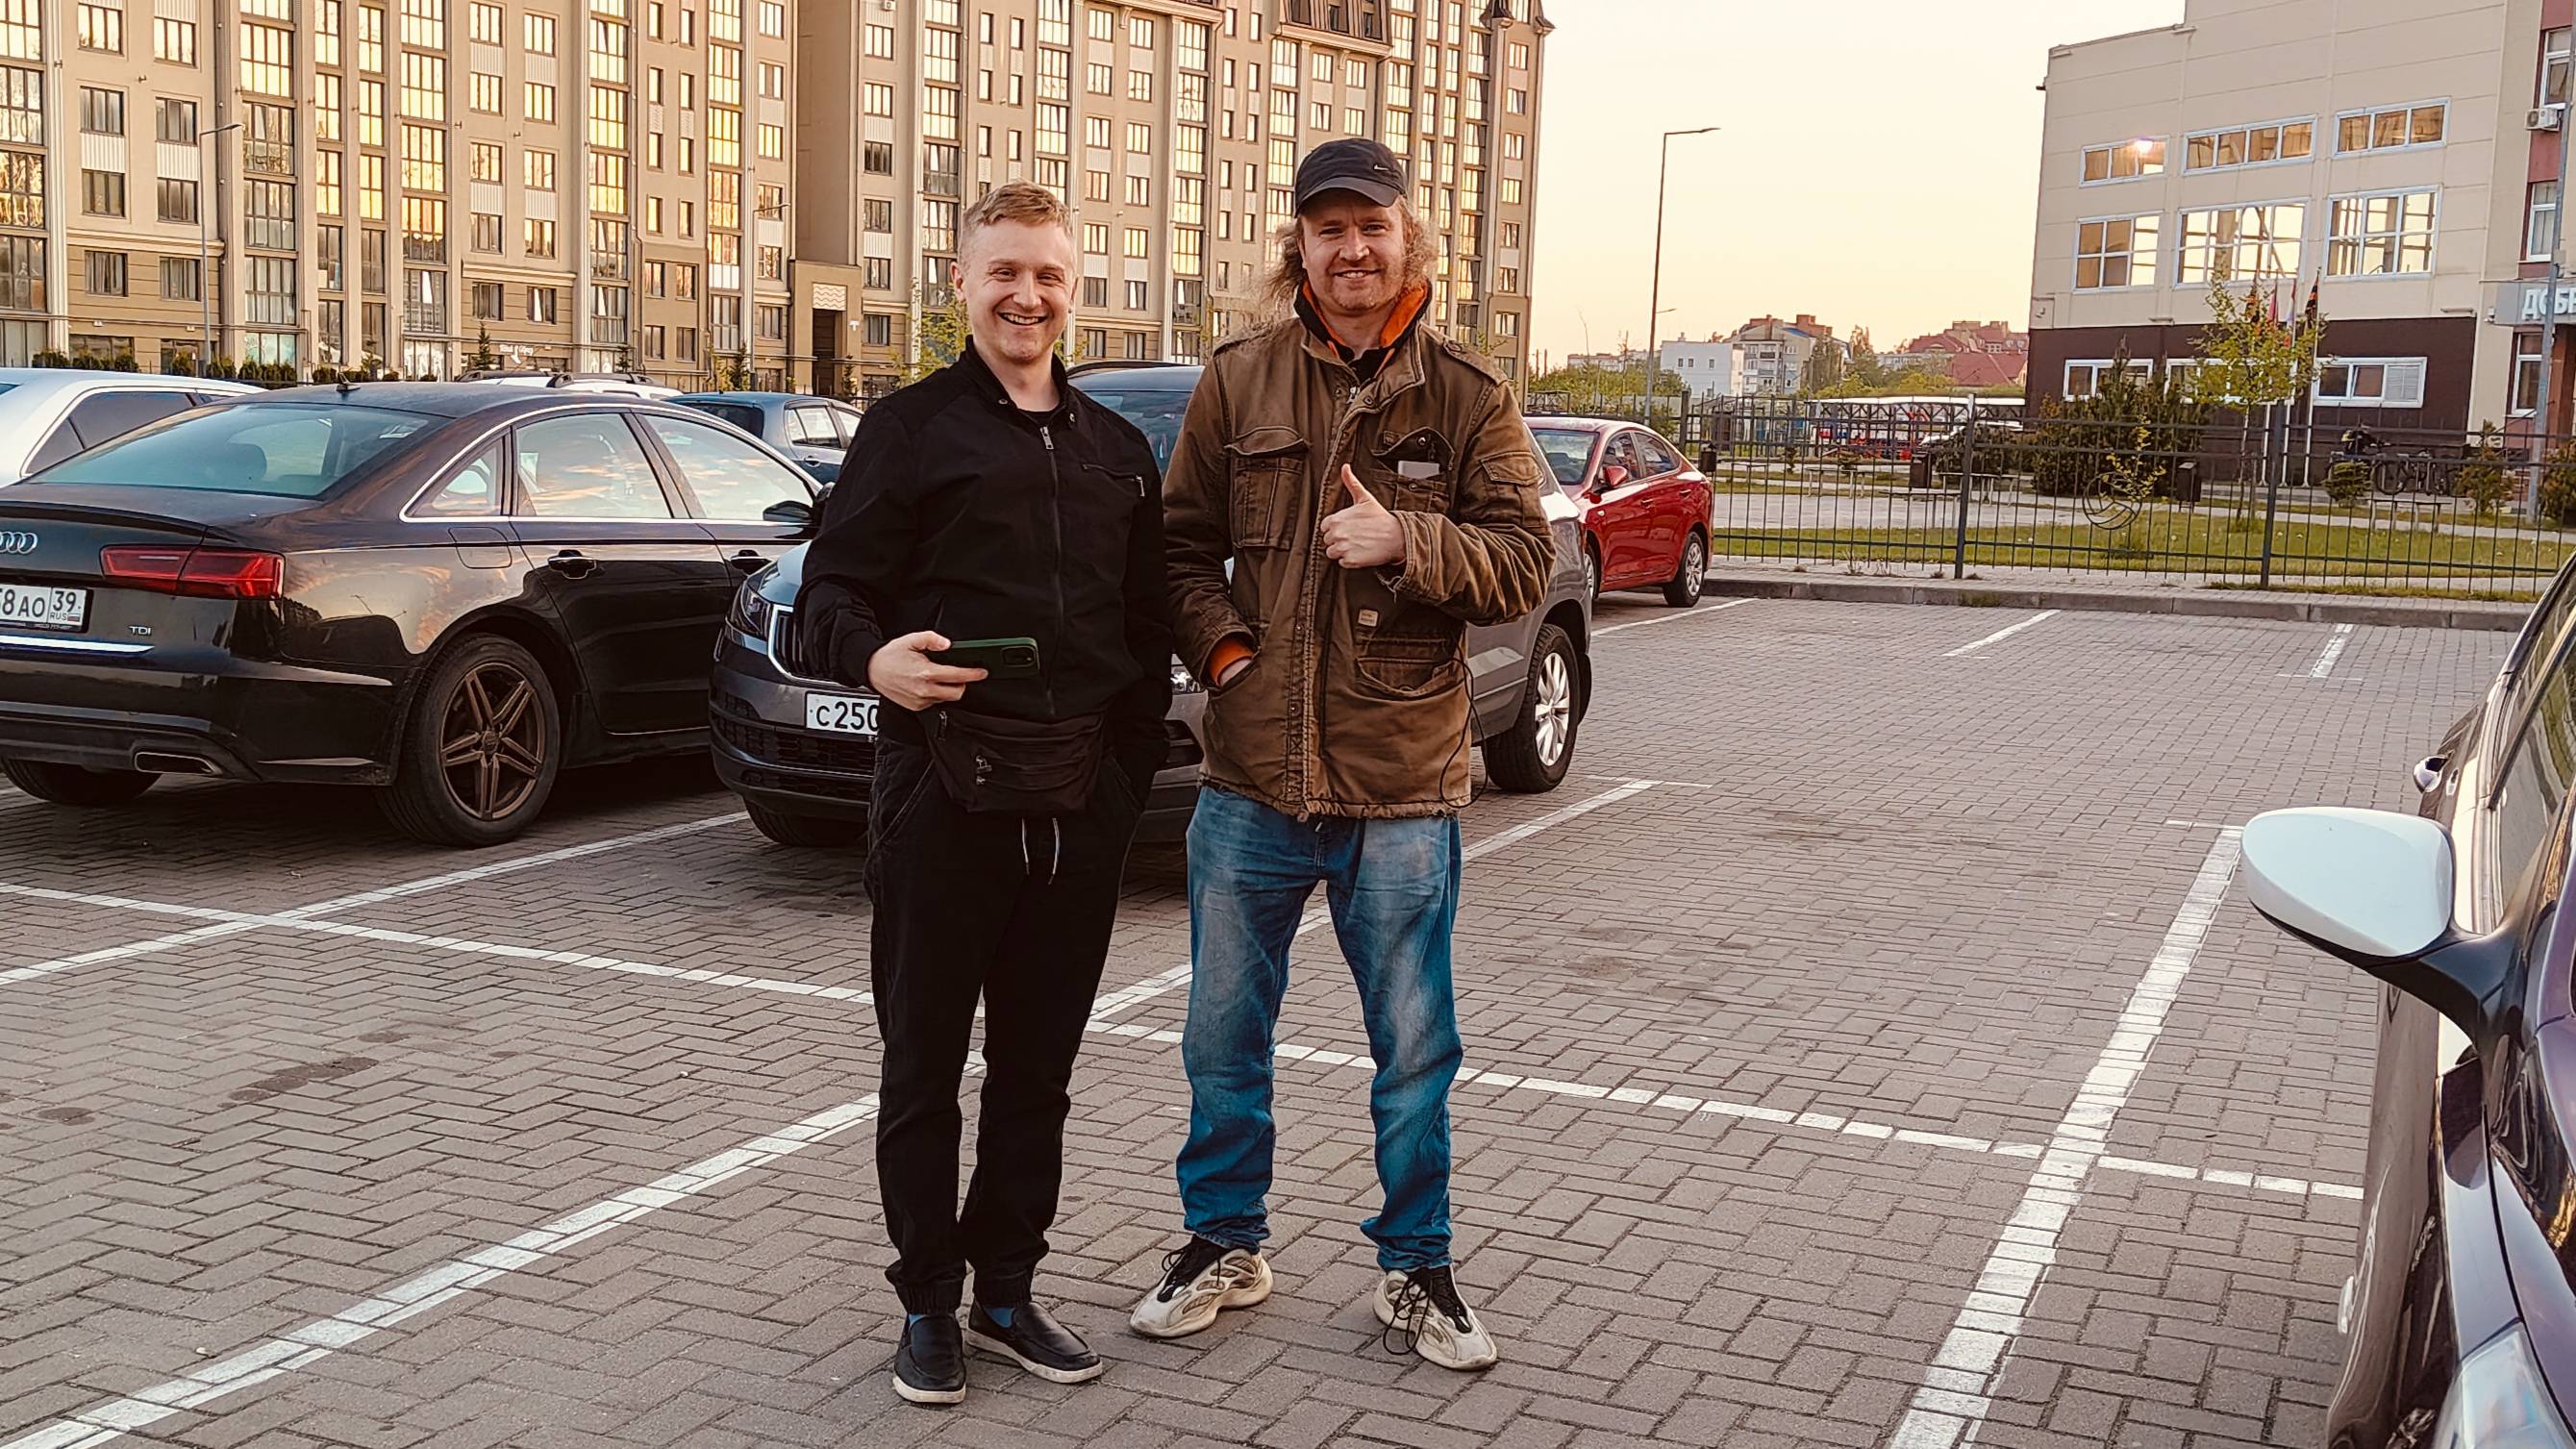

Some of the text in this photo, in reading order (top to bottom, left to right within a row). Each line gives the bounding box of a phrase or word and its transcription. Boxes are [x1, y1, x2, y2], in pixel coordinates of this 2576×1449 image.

[0, 587, 77, 617] 8AO 39
[50, 612, 67, 621] RUS
[129, 625, 152, 636] TDI
